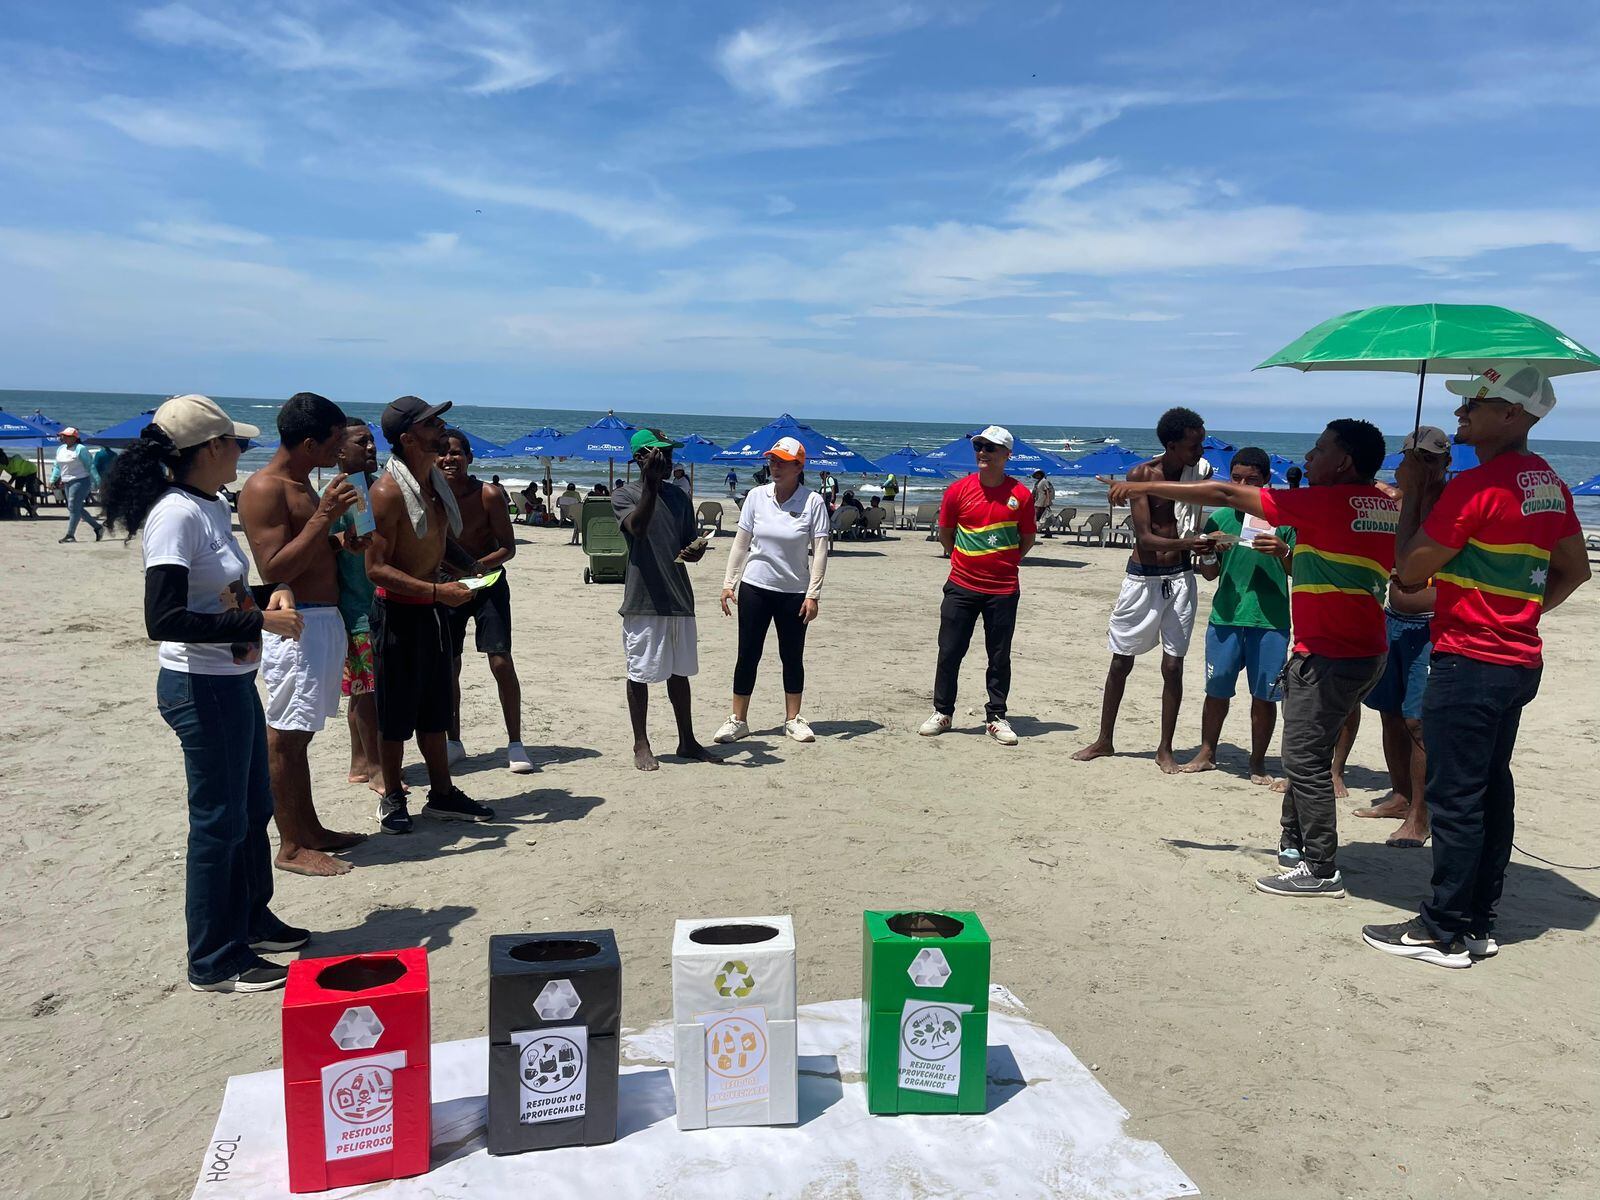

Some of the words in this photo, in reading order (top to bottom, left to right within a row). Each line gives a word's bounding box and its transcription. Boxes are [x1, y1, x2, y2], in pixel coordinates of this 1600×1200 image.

[1526, 489, 1535, 499] DE
[1351, 498, 1399, 511] GESTORE
[909, 1061, 946, 1071] RESIDUOS
[904, 1078, 946, 1089] ORGANICOS
[526, 1096, 567, 1109] RESIDUOS
[569, 1093, 582, 1102] NO
[520, 1104, 586, 1121] APROVECHABLE
[341, 1123, 392, 1140] RESIDUOS
[336, 1136, 394, 1154] PELIGROSO
[206, 1135, 242, 1183] HOCOL
